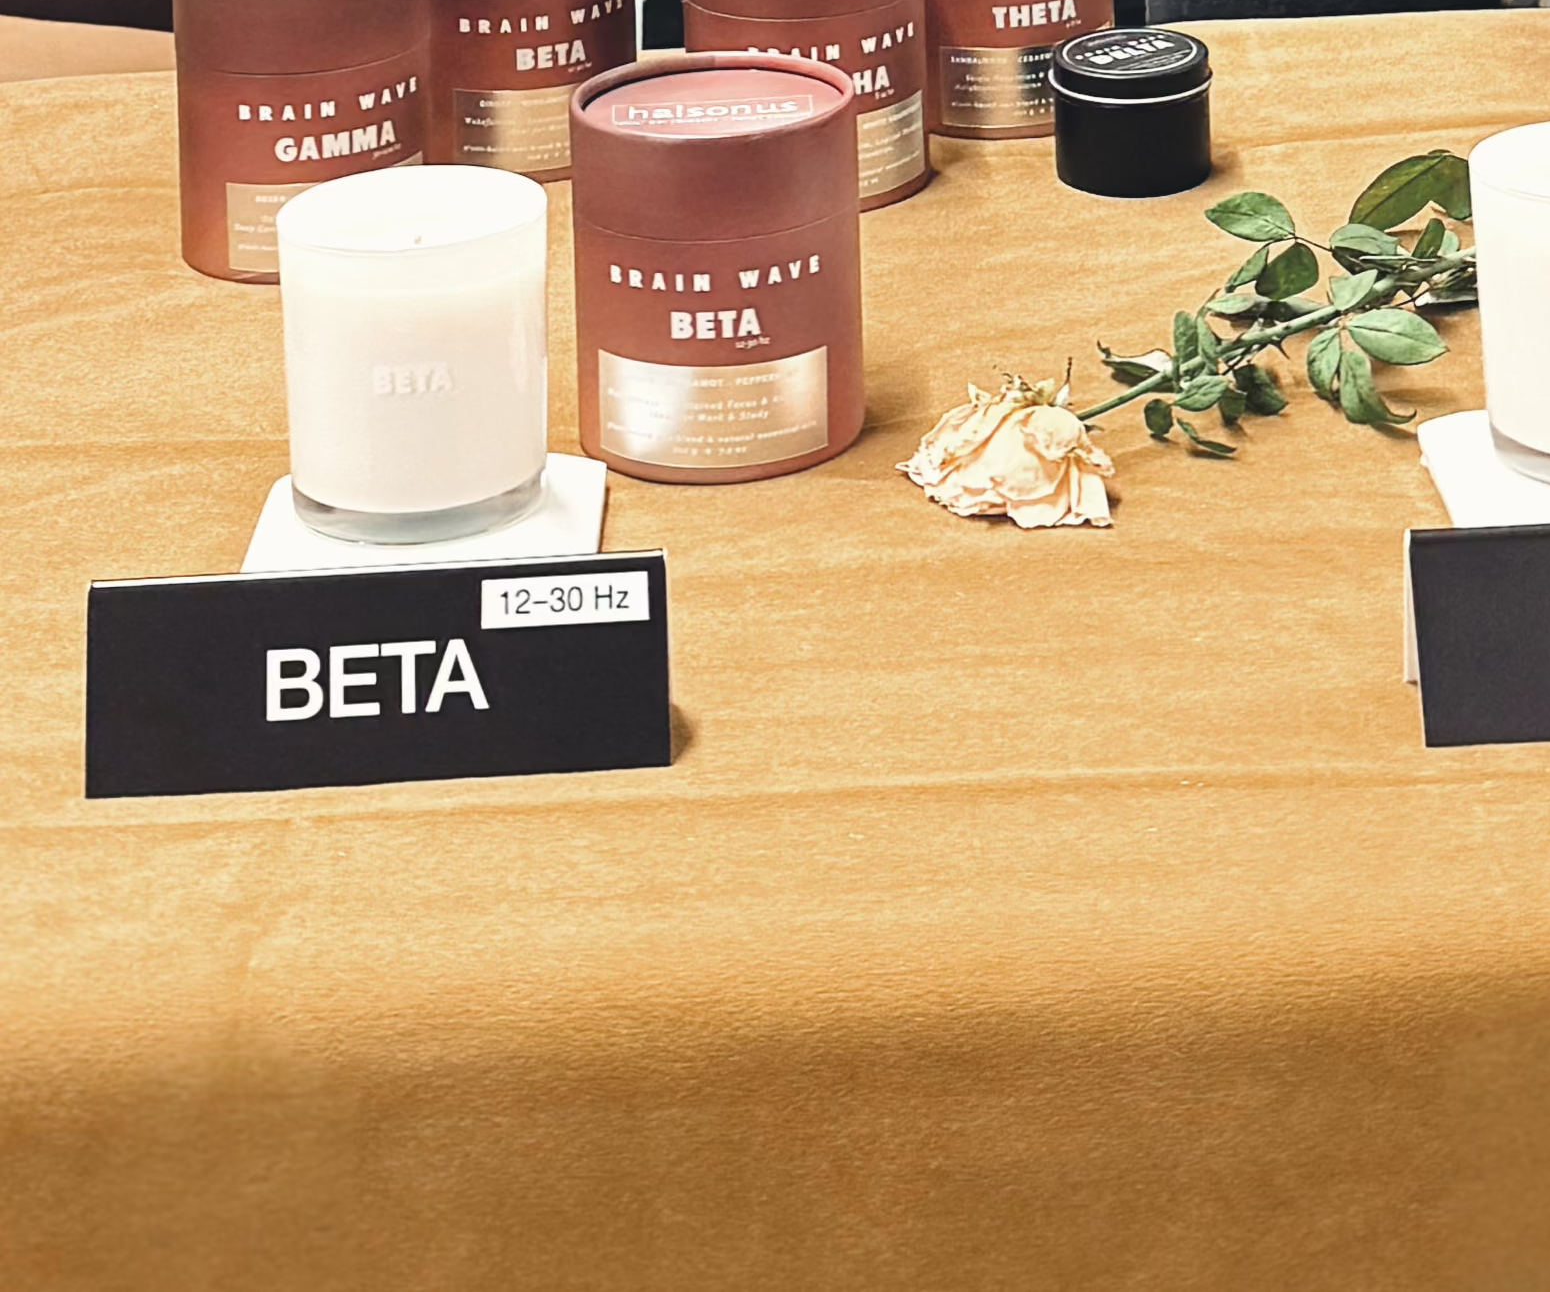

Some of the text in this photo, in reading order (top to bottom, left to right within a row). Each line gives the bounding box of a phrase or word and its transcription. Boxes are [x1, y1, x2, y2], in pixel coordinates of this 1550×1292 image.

[458, 15, 550, 34] BRAIN
[515, 38, 587, 72] BETA
[238, 76, 418, 122] BRAIN WAVE
[626, 100, 799, 121] halsonus
[274, 119, 397, 163] GAMMA
[609, 254, 821, 292] BRAIN WAVE
[670, 307, 763, 340] BETA
[372, 361, 456, 397] BETA
[593, 583, 631, 611] Hz
[265, 637, 490, 723] BETA
